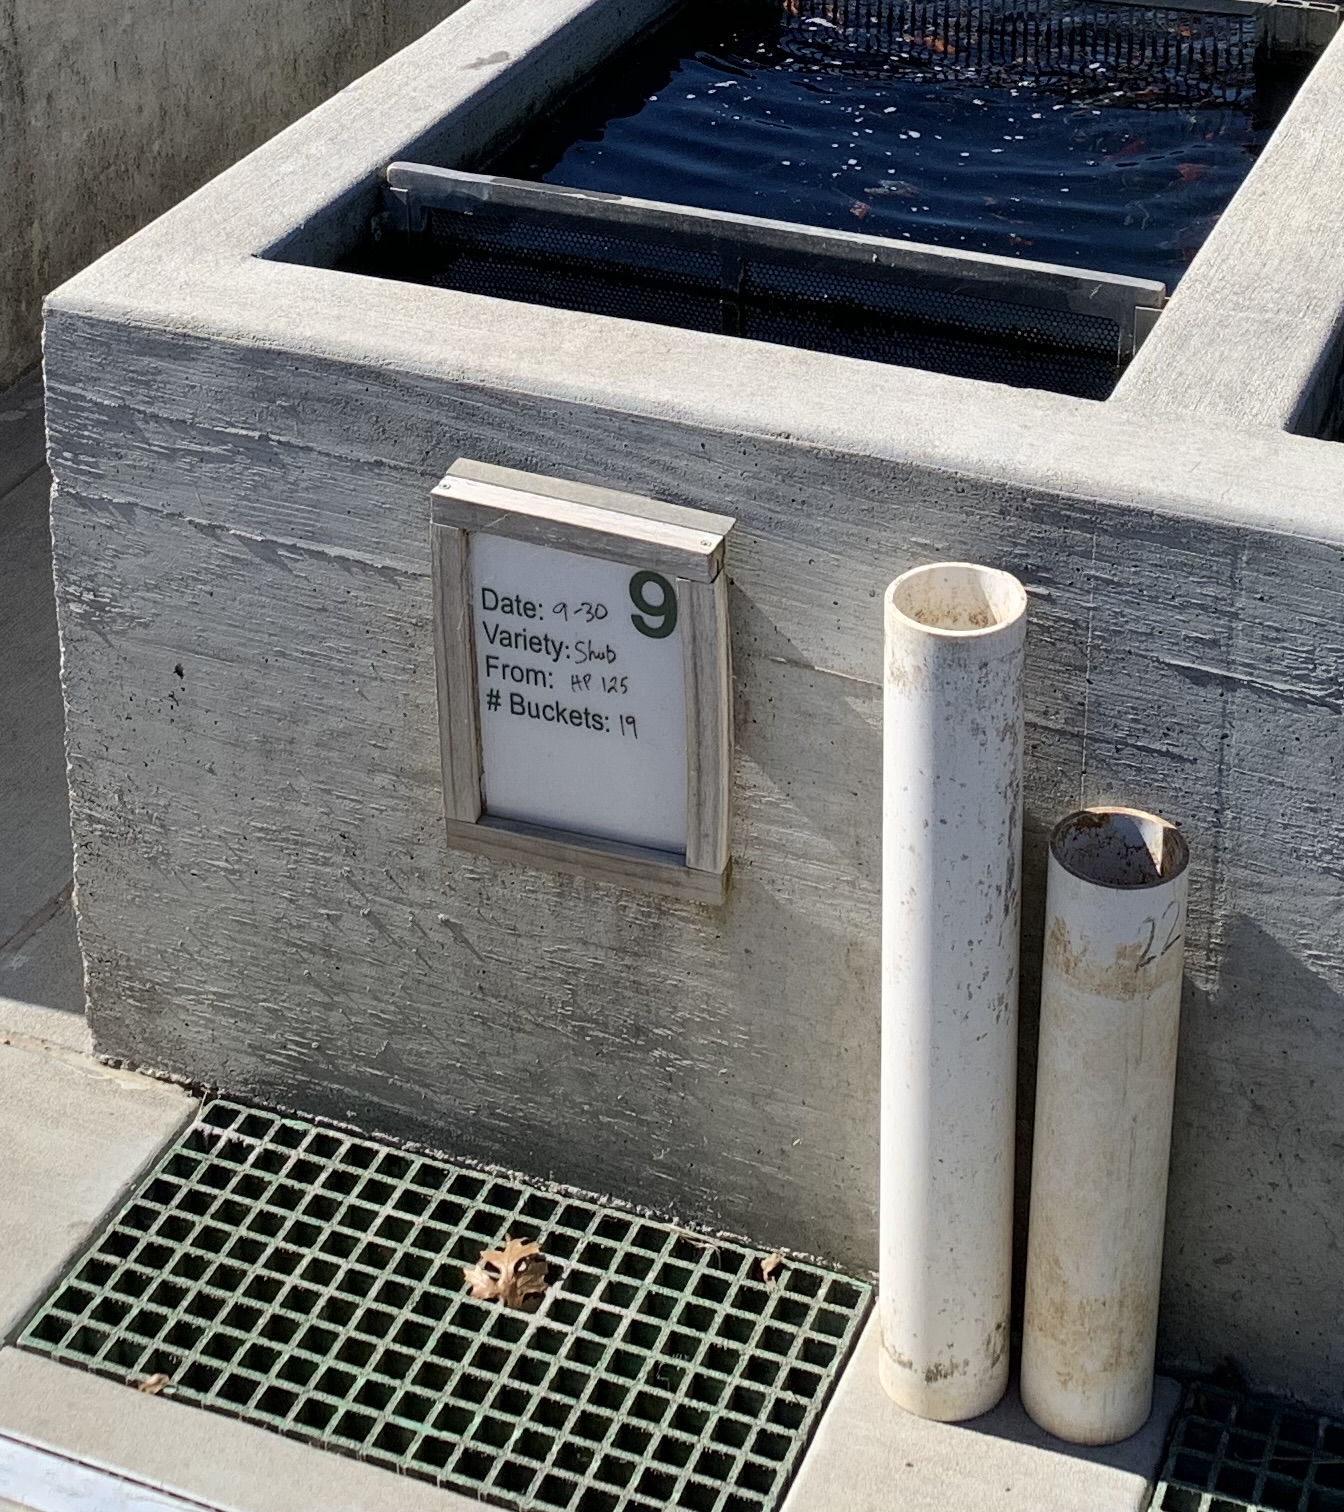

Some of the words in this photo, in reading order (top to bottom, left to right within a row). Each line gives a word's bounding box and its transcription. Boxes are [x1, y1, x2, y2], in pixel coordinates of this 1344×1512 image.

[481, 587, 544, 621] Date:
[628, 570, 678, 639] 9
[482, 620, 571, 662] Variety:
[485, 654, 554, 689] From:
[486, 687, 502, 712] #
[509, 692, 610, 733] Buckets:
[619, 714, 639, 739] 19
